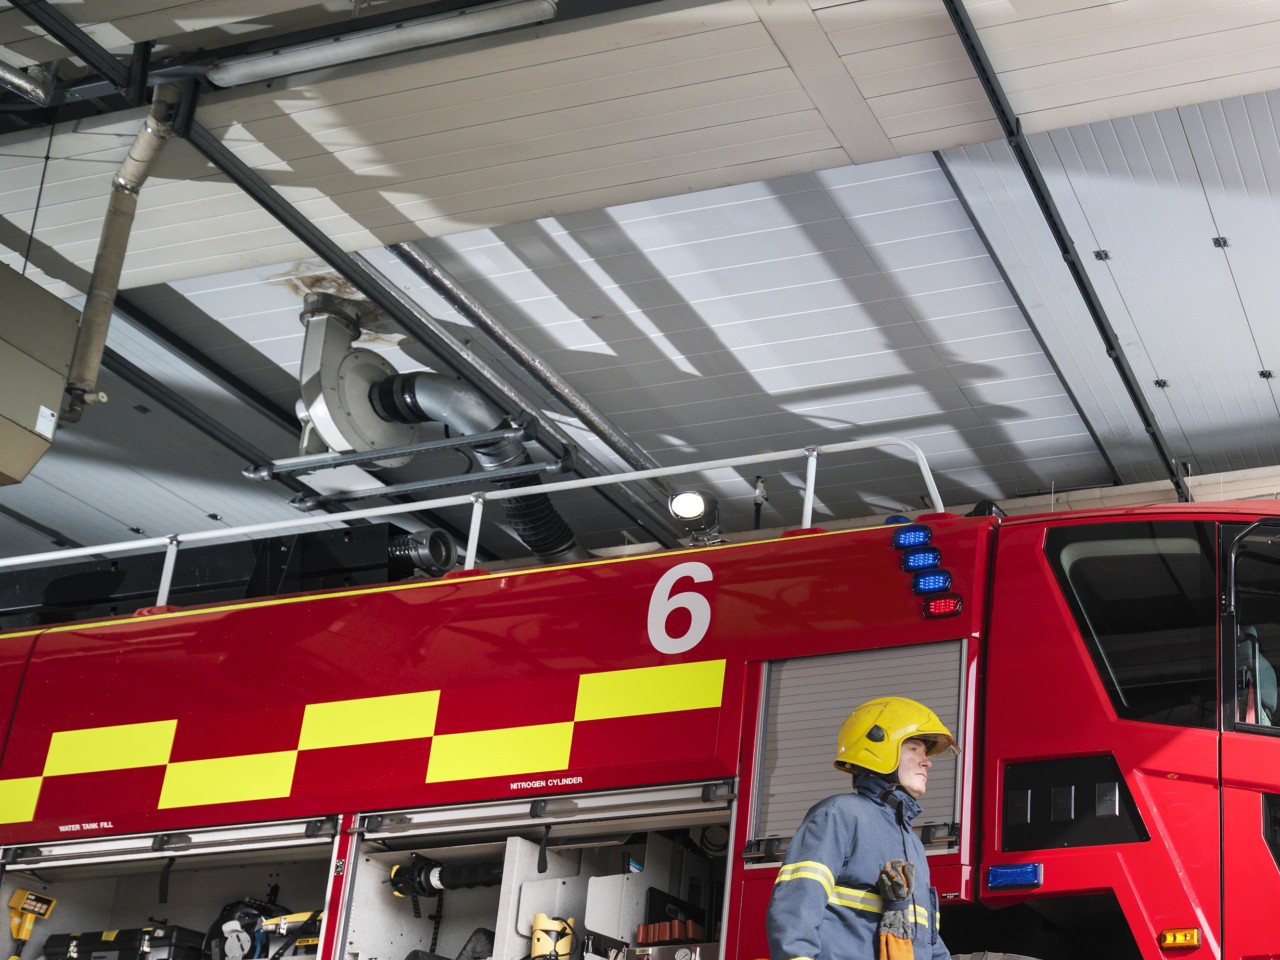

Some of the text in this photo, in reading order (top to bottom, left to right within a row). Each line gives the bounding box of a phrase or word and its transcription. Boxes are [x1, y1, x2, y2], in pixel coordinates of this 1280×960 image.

[647, 561, 714, 655] 6
[510, 777, 583, 790] NITROGEN CYLINDER
[59, 824, 81, 832] WATER
